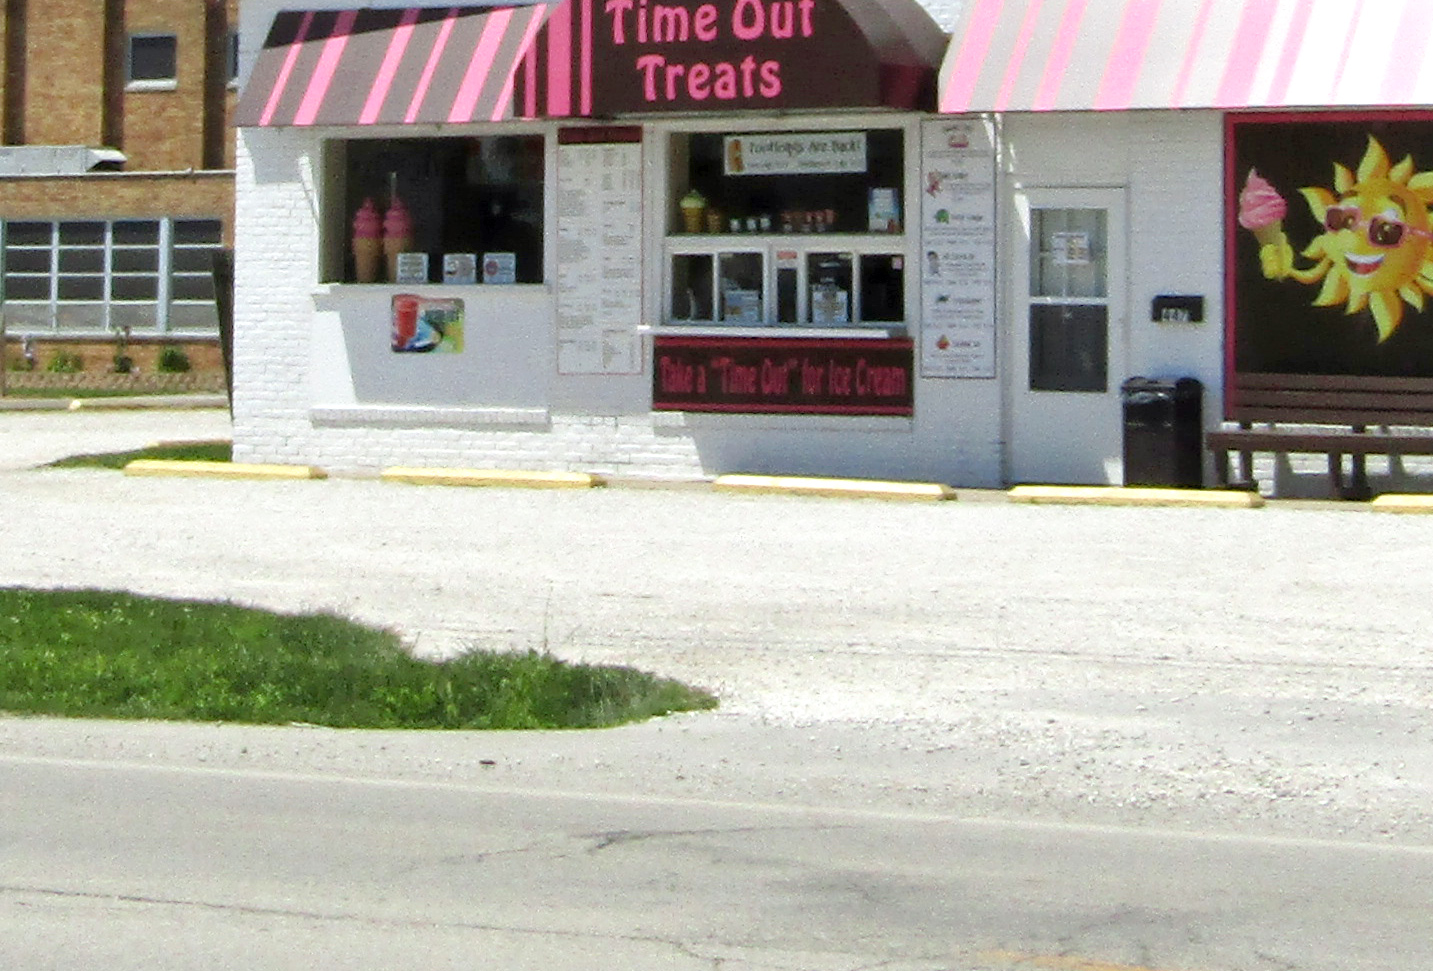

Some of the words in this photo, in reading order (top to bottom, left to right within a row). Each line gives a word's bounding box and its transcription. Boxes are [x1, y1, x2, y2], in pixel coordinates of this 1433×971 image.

[635, 53, 783, 101] Treats
[660, 356, 693, 394] Take
[696, 364, 706, 394] a
[802, 358, 824, 396] for
[829, 358, 852, 396] Ice
[856, 358, 907, 396] Cream
